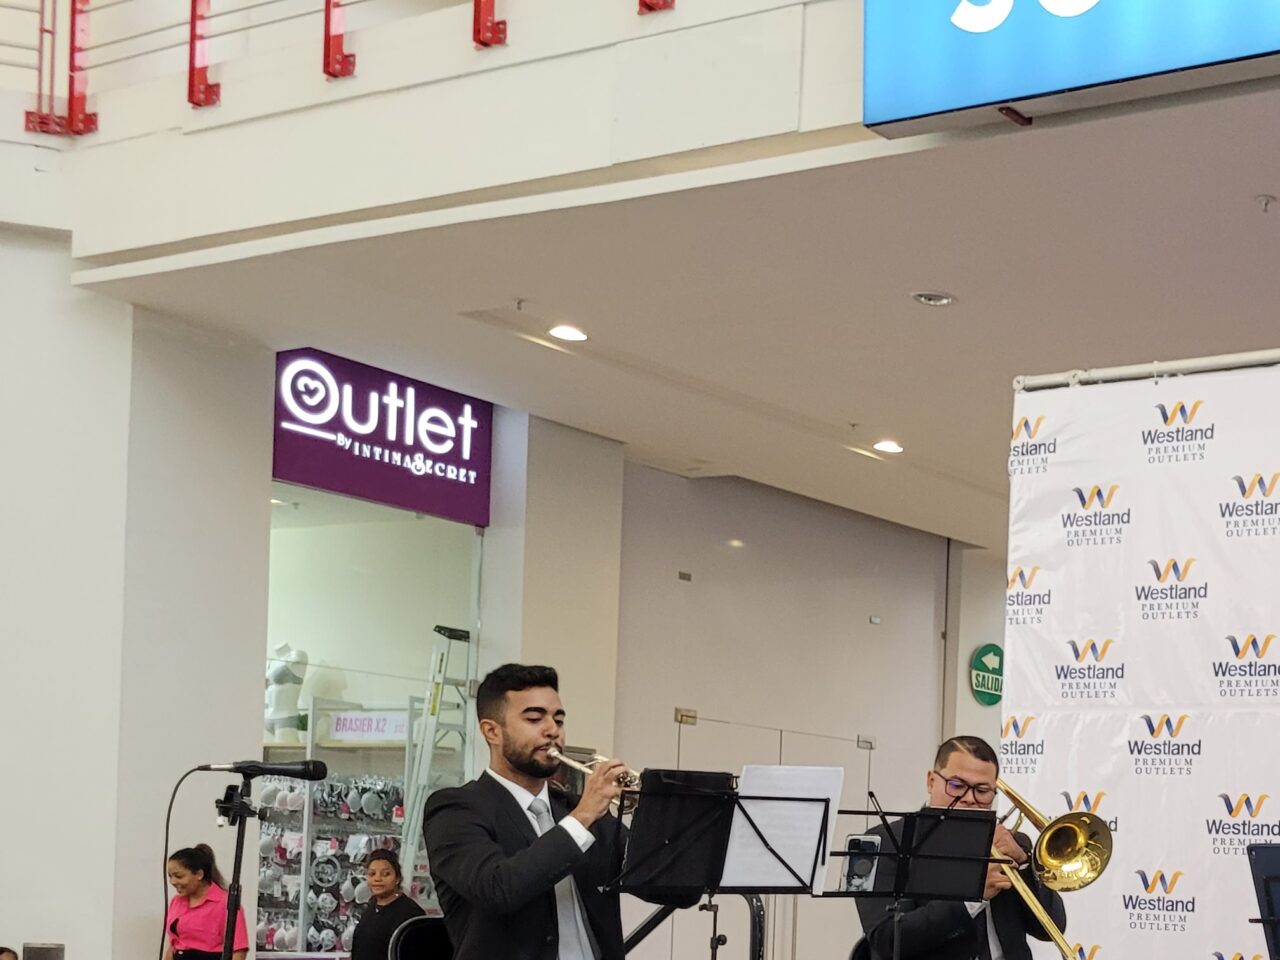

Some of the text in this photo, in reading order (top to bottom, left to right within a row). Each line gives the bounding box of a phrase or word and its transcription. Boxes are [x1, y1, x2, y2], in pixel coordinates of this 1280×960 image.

[280, 359, 478, 460] Outlet
[1142, 424, 1214, 445] Westland
[1010, 438, 1056, 457] stland
[1148, 444, 1205, 454] PREMIUM
[1148, 453, 1204, 463] OUTLETS
[1062, 508, 1130, 528] Westland
[1067, 528, 1122, 537] PREMIUM
[1067, 537, 1121, 546] OUTLETS
[1135, 582, 1207, 601] Westland
[1008, 589, 1051, 606] stland
[1142, 602, 1199, 611] PREMIUM
[1142, 611, 1198, 619] OUTLETS
[1008, 617, 1042, 625] TLETS
[1055, 663, 1124, 680] Westland
[1062, 682, 1116, 690] PREMIUM
[1219, 679, 1279, 687] PREMIUM
[335, 717, 372, 733] BRASIER
[1001, 740, 1044, 756] stland
[1128, 739, 1201, 755] Westland
[1135, 767, 1191, 775] OUTLETS
[1213, 847, 1248, 855] OUTL
[1122, 895, 1195, 913] Westland
[1129, 913, 1186, 922] PREMIUM
[1130, 922, 1185, 931] OUTLETS
